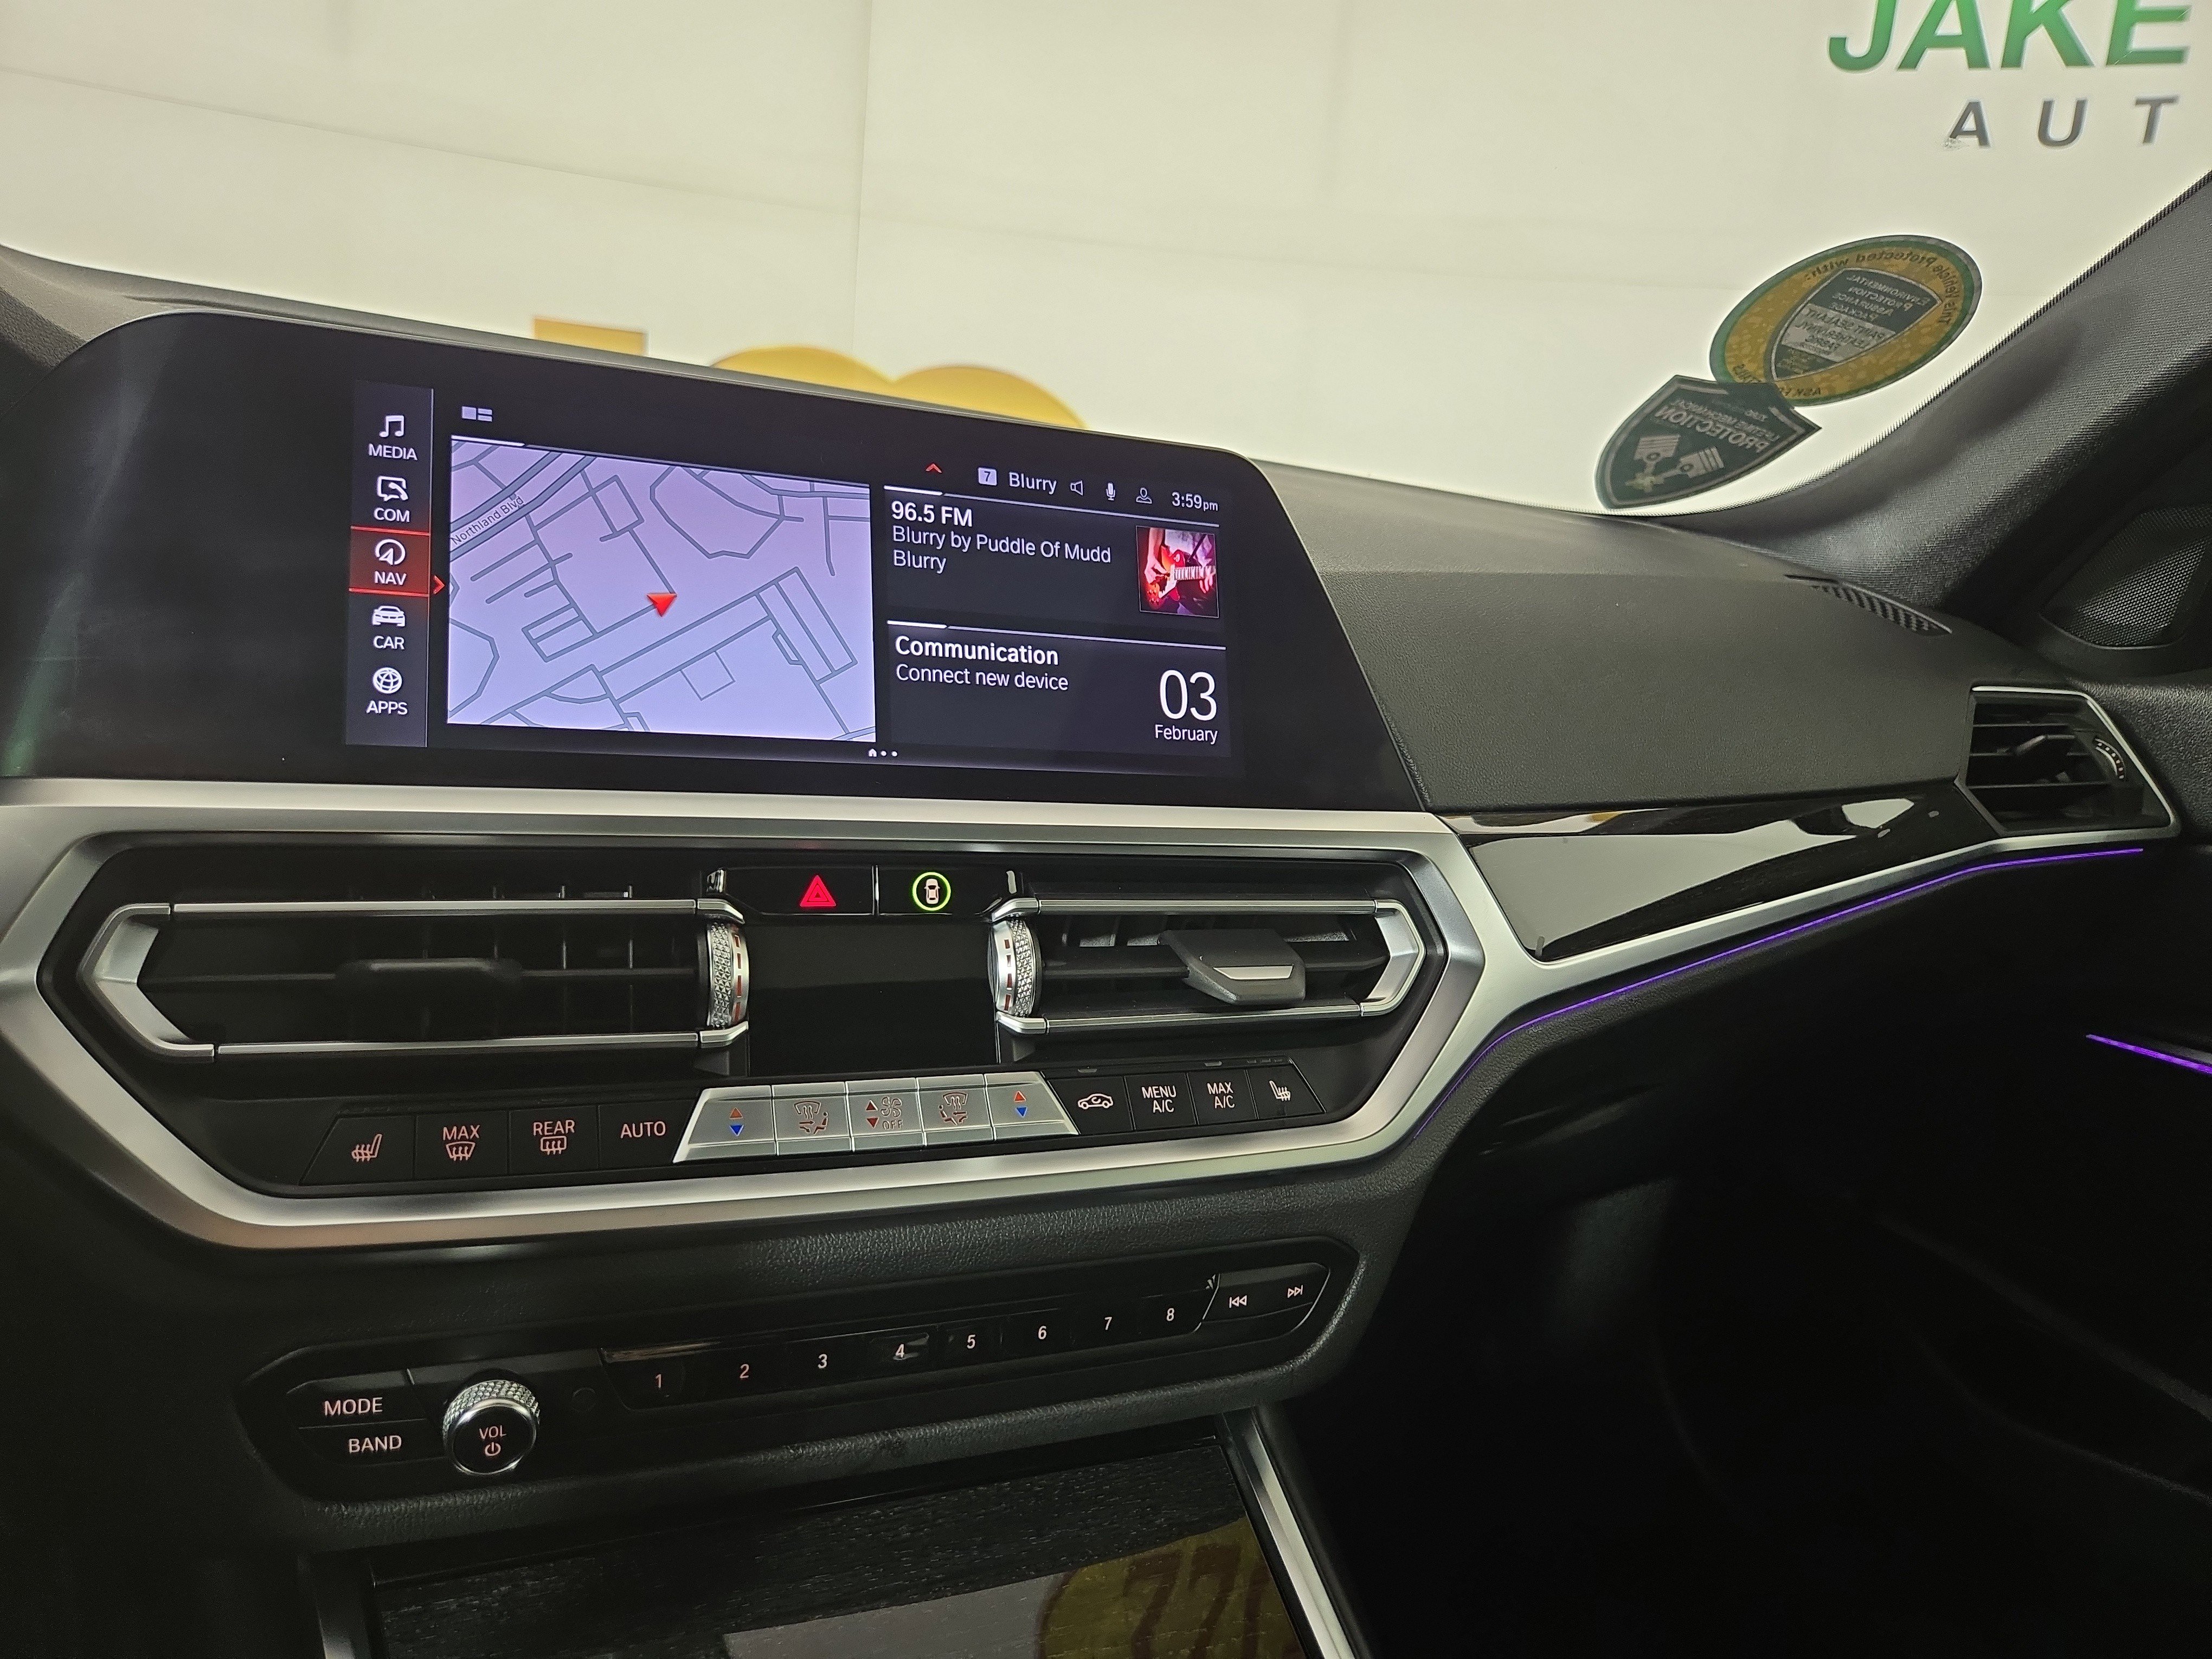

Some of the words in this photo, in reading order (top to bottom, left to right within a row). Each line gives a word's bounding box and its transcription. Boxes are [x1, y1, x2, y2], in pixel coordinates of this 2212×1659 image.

[1828, 0, 2190, 71] JAKE
[1949, 95, 2179, 148] AUT
[368, 443, 418, 461] MEDIA
[982, 468, 992, 484] 7
[1008, 472, 1057, 495] Blurry
[1172, 491, 1218, 511] 3:59pm
[373, 507, 410, 523] COM
[451, 512, 501, 545] Northland
[500, 496, 524, 517] Blvd
[891, 500, 935, 523] 96.5
[941, 506, 972, 527] FM
[892, 525, 946, 550] Blurry
[950, 531, 972, 552] by
[976, 533, 1036, 556] Puddle
[1040, 541, 1060, 558] Of
[1064, 543, 1111, 563] Mudd
[893, 549, 947, 574] Blurry
[374, 570, 407, 586] NAV
[372, 635, 404, 650] CAR
[895, 635, 1059, 666] Communication
[896, 663, 971, 684] Connect
[975, 672, 1010, 686] new
[1014, 671, 1069, 691] device
[1159, 670, 1217, 721] 03
[366, 700, 408, 715] APPS
[1155, 724, 1218, 745] February
[1141, 1085, 1176, 1098] MENU
[1207, 1082, 1233, 1095] MAX
[1153, 1099, 1174, 1113] A/C
[1214, 1095, 1235, 1109] A/C
[442, 1124, 480, 1141] MAX
[533, 1120, 575, 1136] REAR
[620, 1121, 666, 1139] AUTO
[882, 1118, 904, 1131] OFF
[654, 1373, 663, 1388] 1
[739, 1364, 750, 1380] 2
[817, 1353, 828, 1369] 3
[895, 1343, 906, 1358] 4
[967, 1334, 976, 1350] 5
[1037, 1326, 1047, 1340] 6
[1104, 1317, 1113, 1331] 7
[1166, 1308, 1175, 1322] 8
[324, 1397, 383, 1416] MODE
[479, 1425, 506, 1440] VOL
[348, 1435, 402, 1454] BAND
